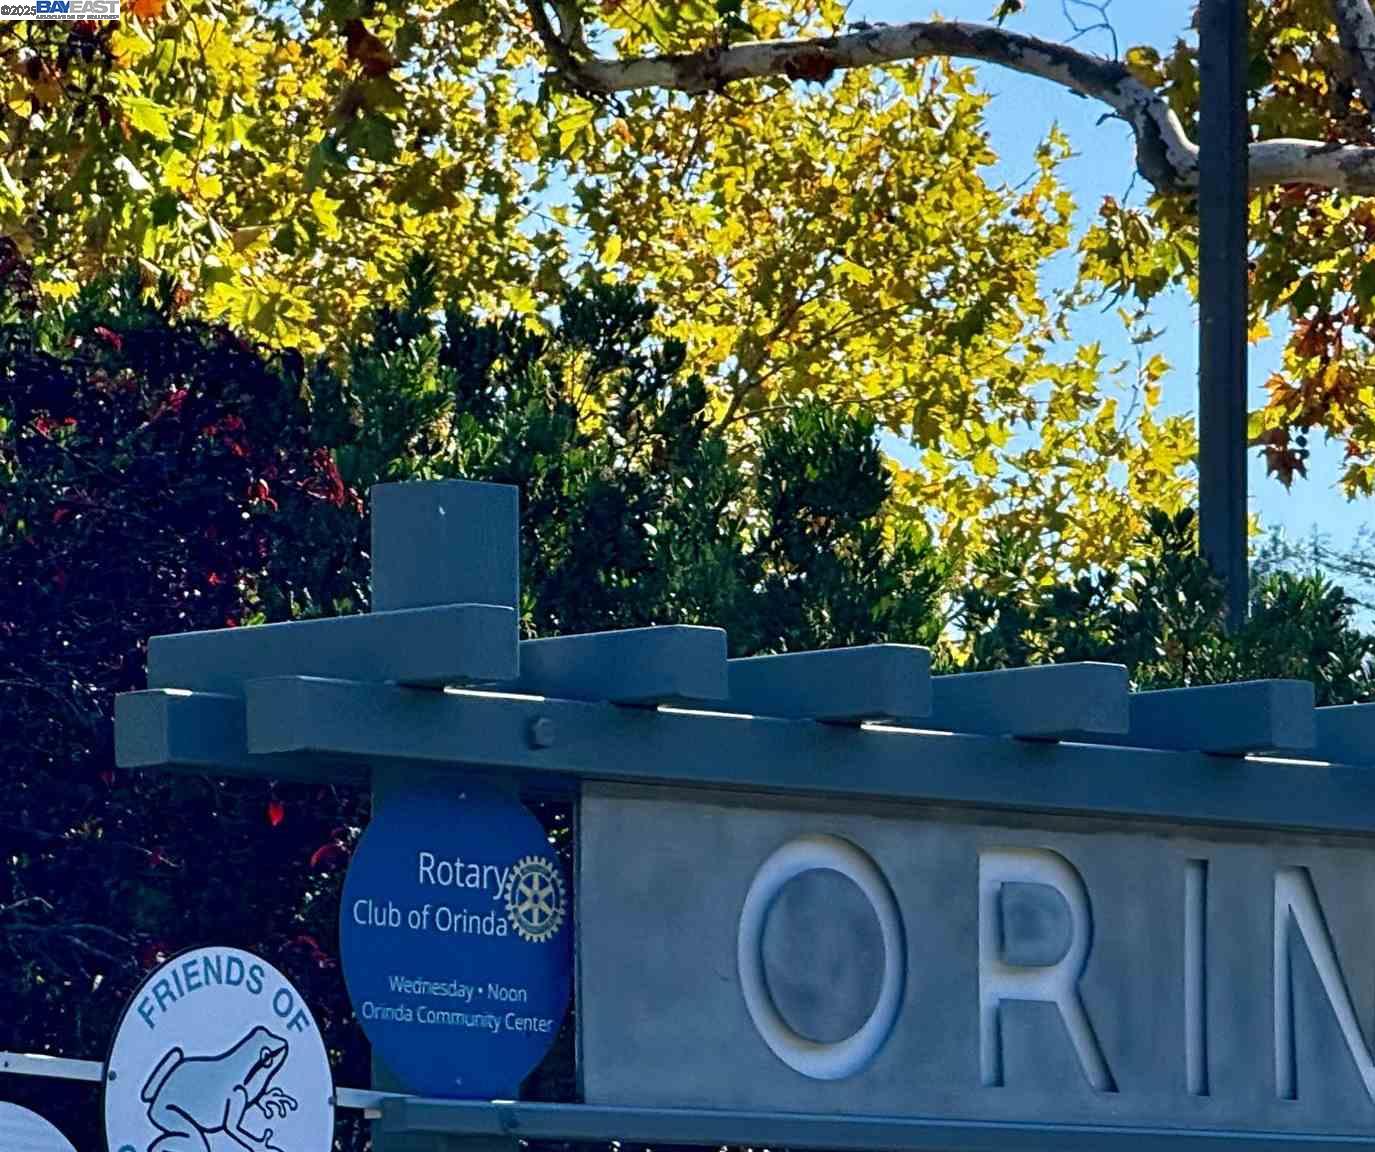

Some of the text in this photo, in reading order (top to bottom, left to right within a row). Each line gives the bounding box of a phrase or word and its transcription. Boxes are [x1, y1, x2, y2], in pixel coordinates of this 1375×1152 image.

[419, 852, 510, 900] Rotary
[353, 899, 508, 937] Club of Orinda
[137, 955, 310, 1033] FRIENDS OF
[389, 975, 527, 1002] Wednesday Noon
[362, 1002, 552, 1033] Orinda Community Center
